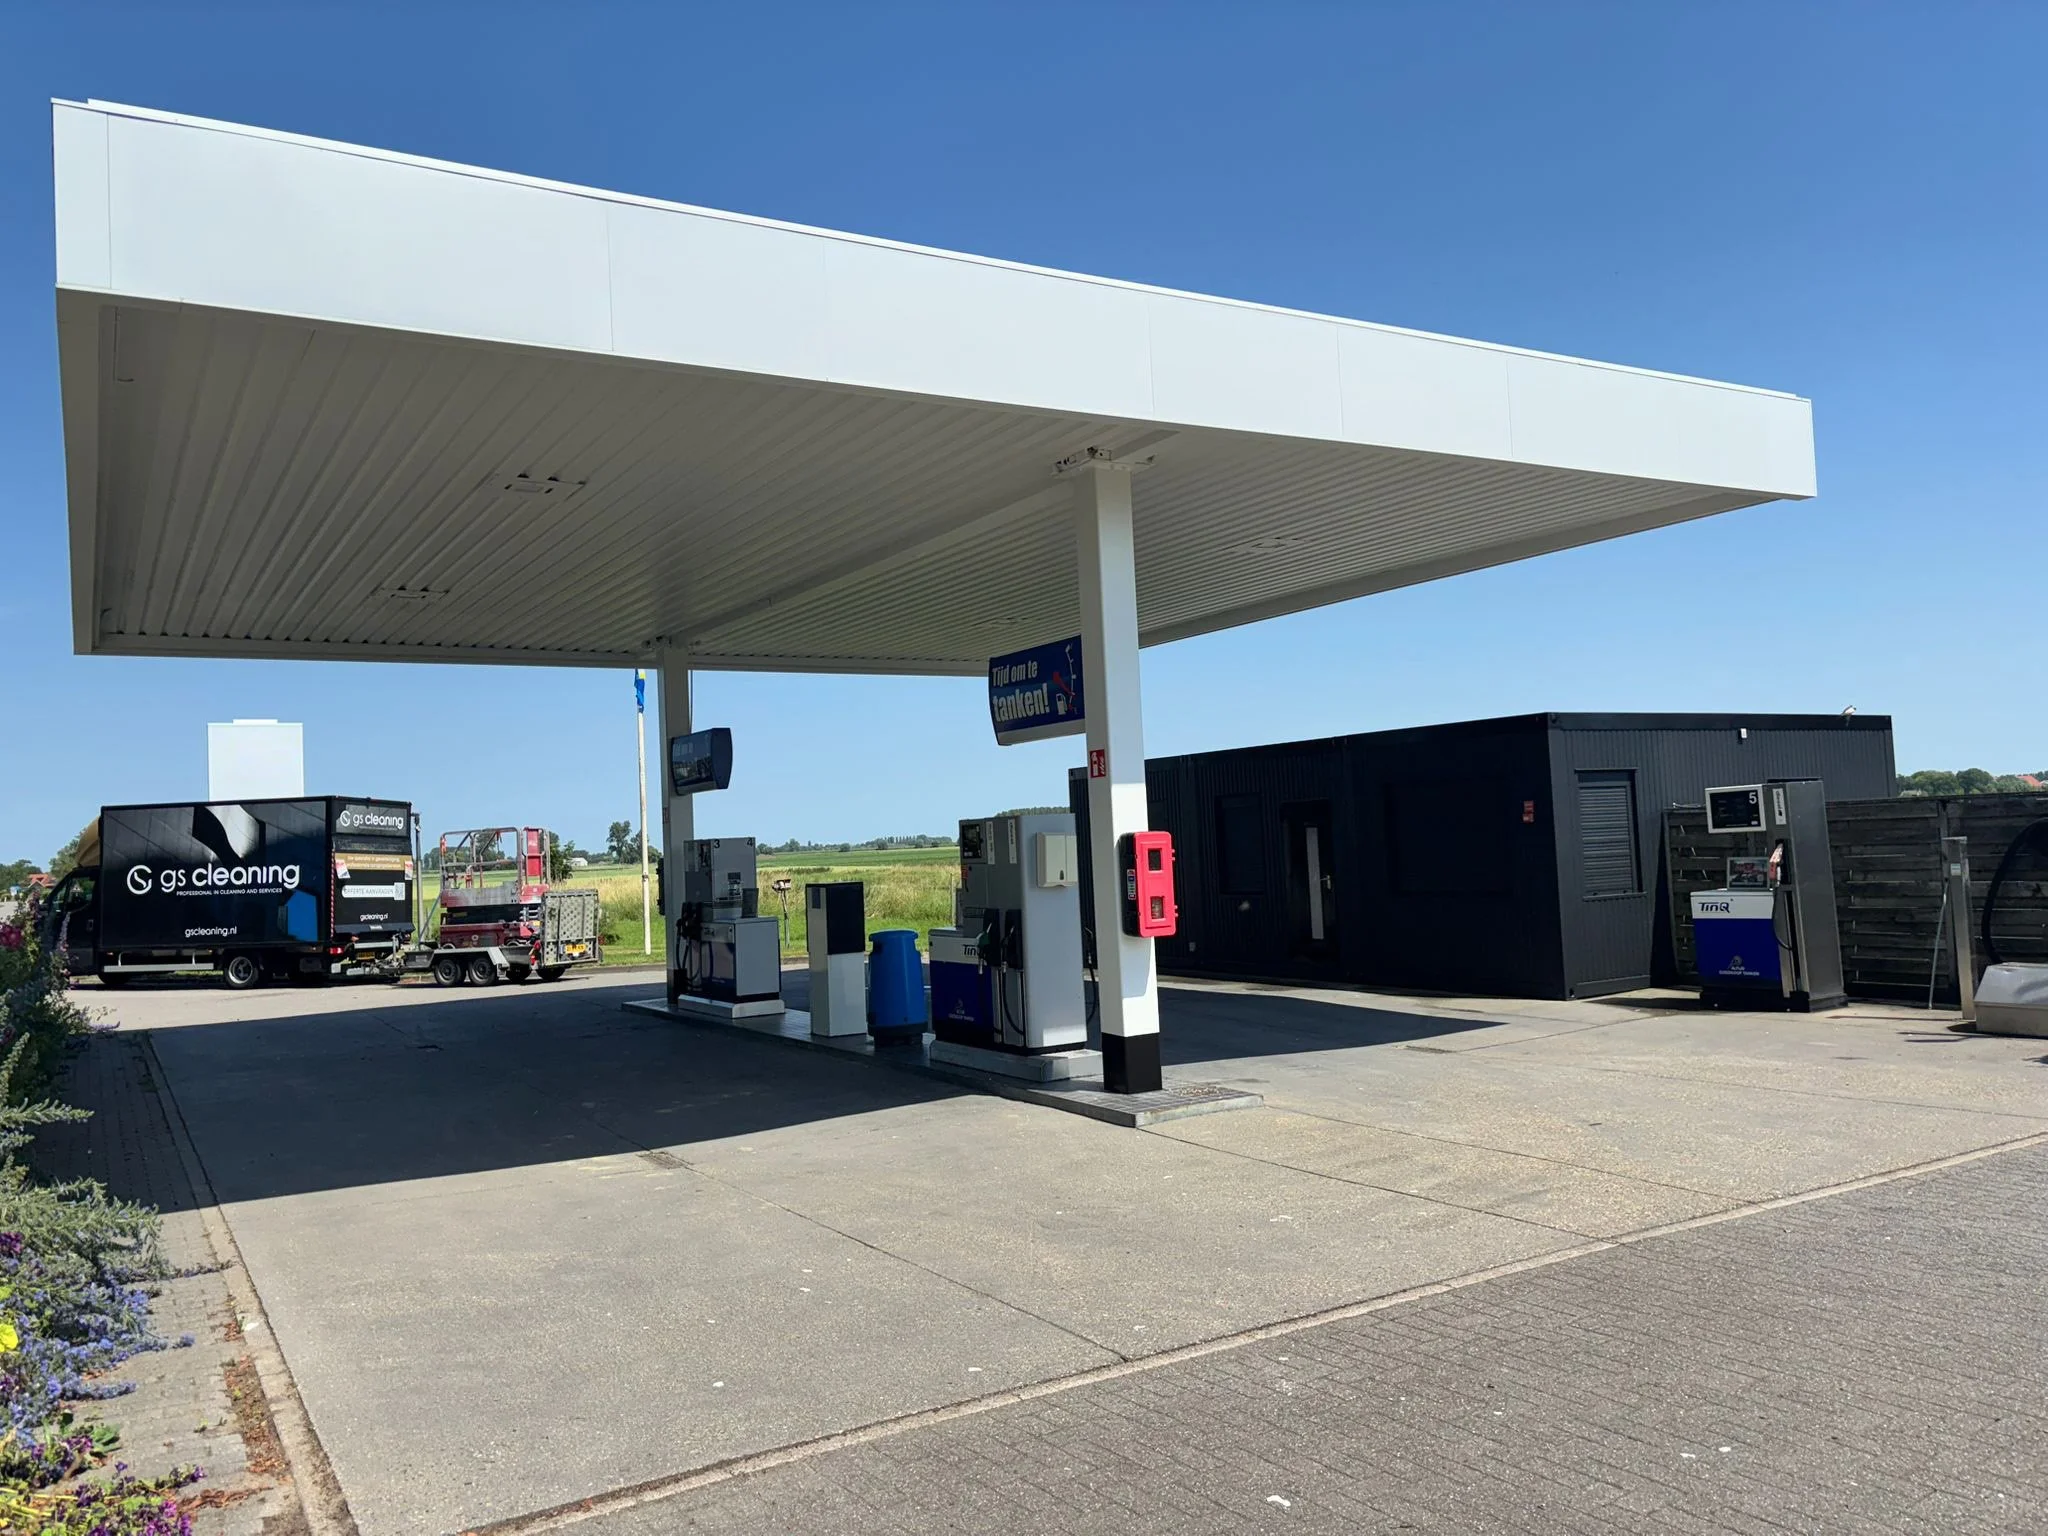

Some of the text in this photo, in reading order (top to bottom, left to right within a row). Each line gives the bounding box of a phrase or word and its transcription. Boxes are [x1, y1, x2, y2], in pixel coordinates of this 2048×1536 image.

[991, 660, 1039, 687] Tijd om te
[993, 682, 1050, 722] tanken!
[1749, 791, 1757, 804] 5
[352, 814, 364, 827] gs
[365, 812, 404, 830] cleaning
[713, 839, 720, 849] 3
[746, 837, 753, 847] 4
[160, 869, 186, 893] gs
[191, 862, 300, 890] cleaning
[1698, 901, 1731, 913] TinQ
[360, 912, 388, 922] gscleaning.nl
[184, 926, 238, 938] gscleaning.nl
[961, 943, 979, 956] Tin
